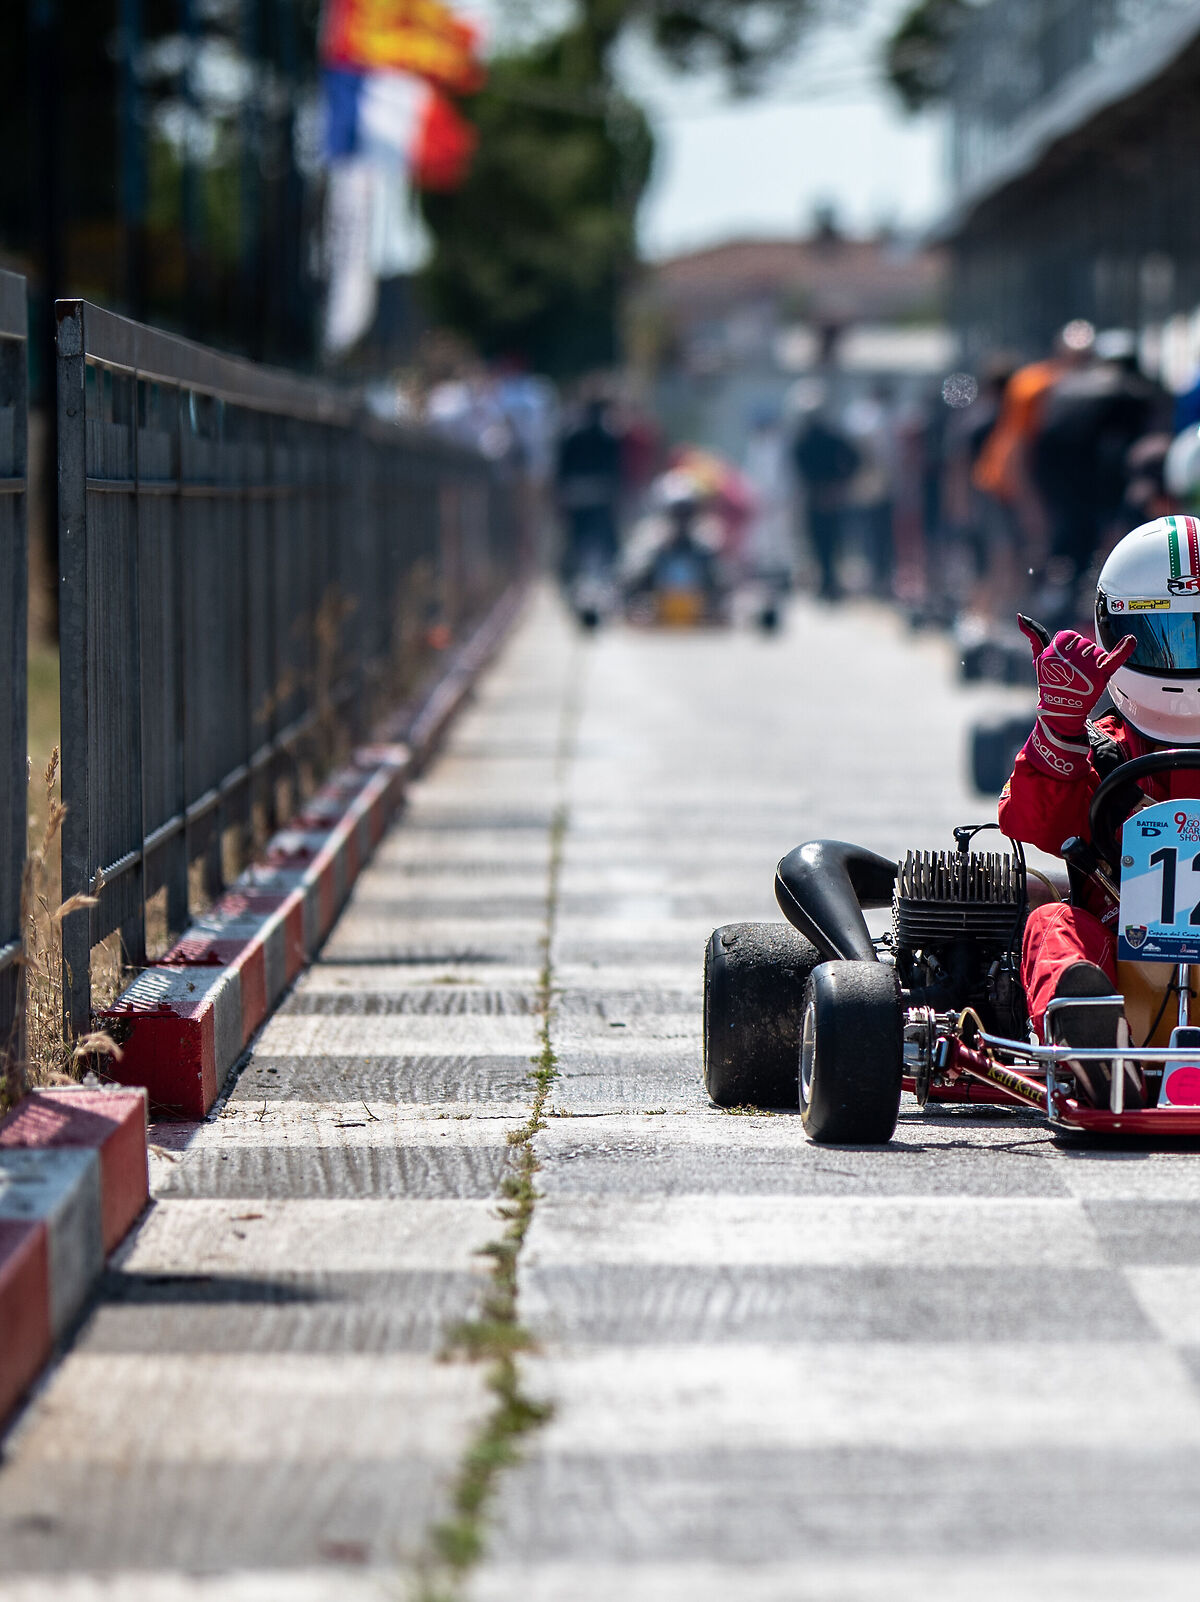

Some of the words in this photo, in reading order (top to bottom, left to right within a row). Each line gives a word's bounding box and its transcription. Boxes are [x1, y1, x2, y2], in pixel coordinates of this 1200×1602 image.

[1136, 820, 1169, 828] BATTERIA
[1174, 811, 1188, 834] 9
[1187, 819, 1200, 828] GO
[1141, 827, 1162, 837] D
